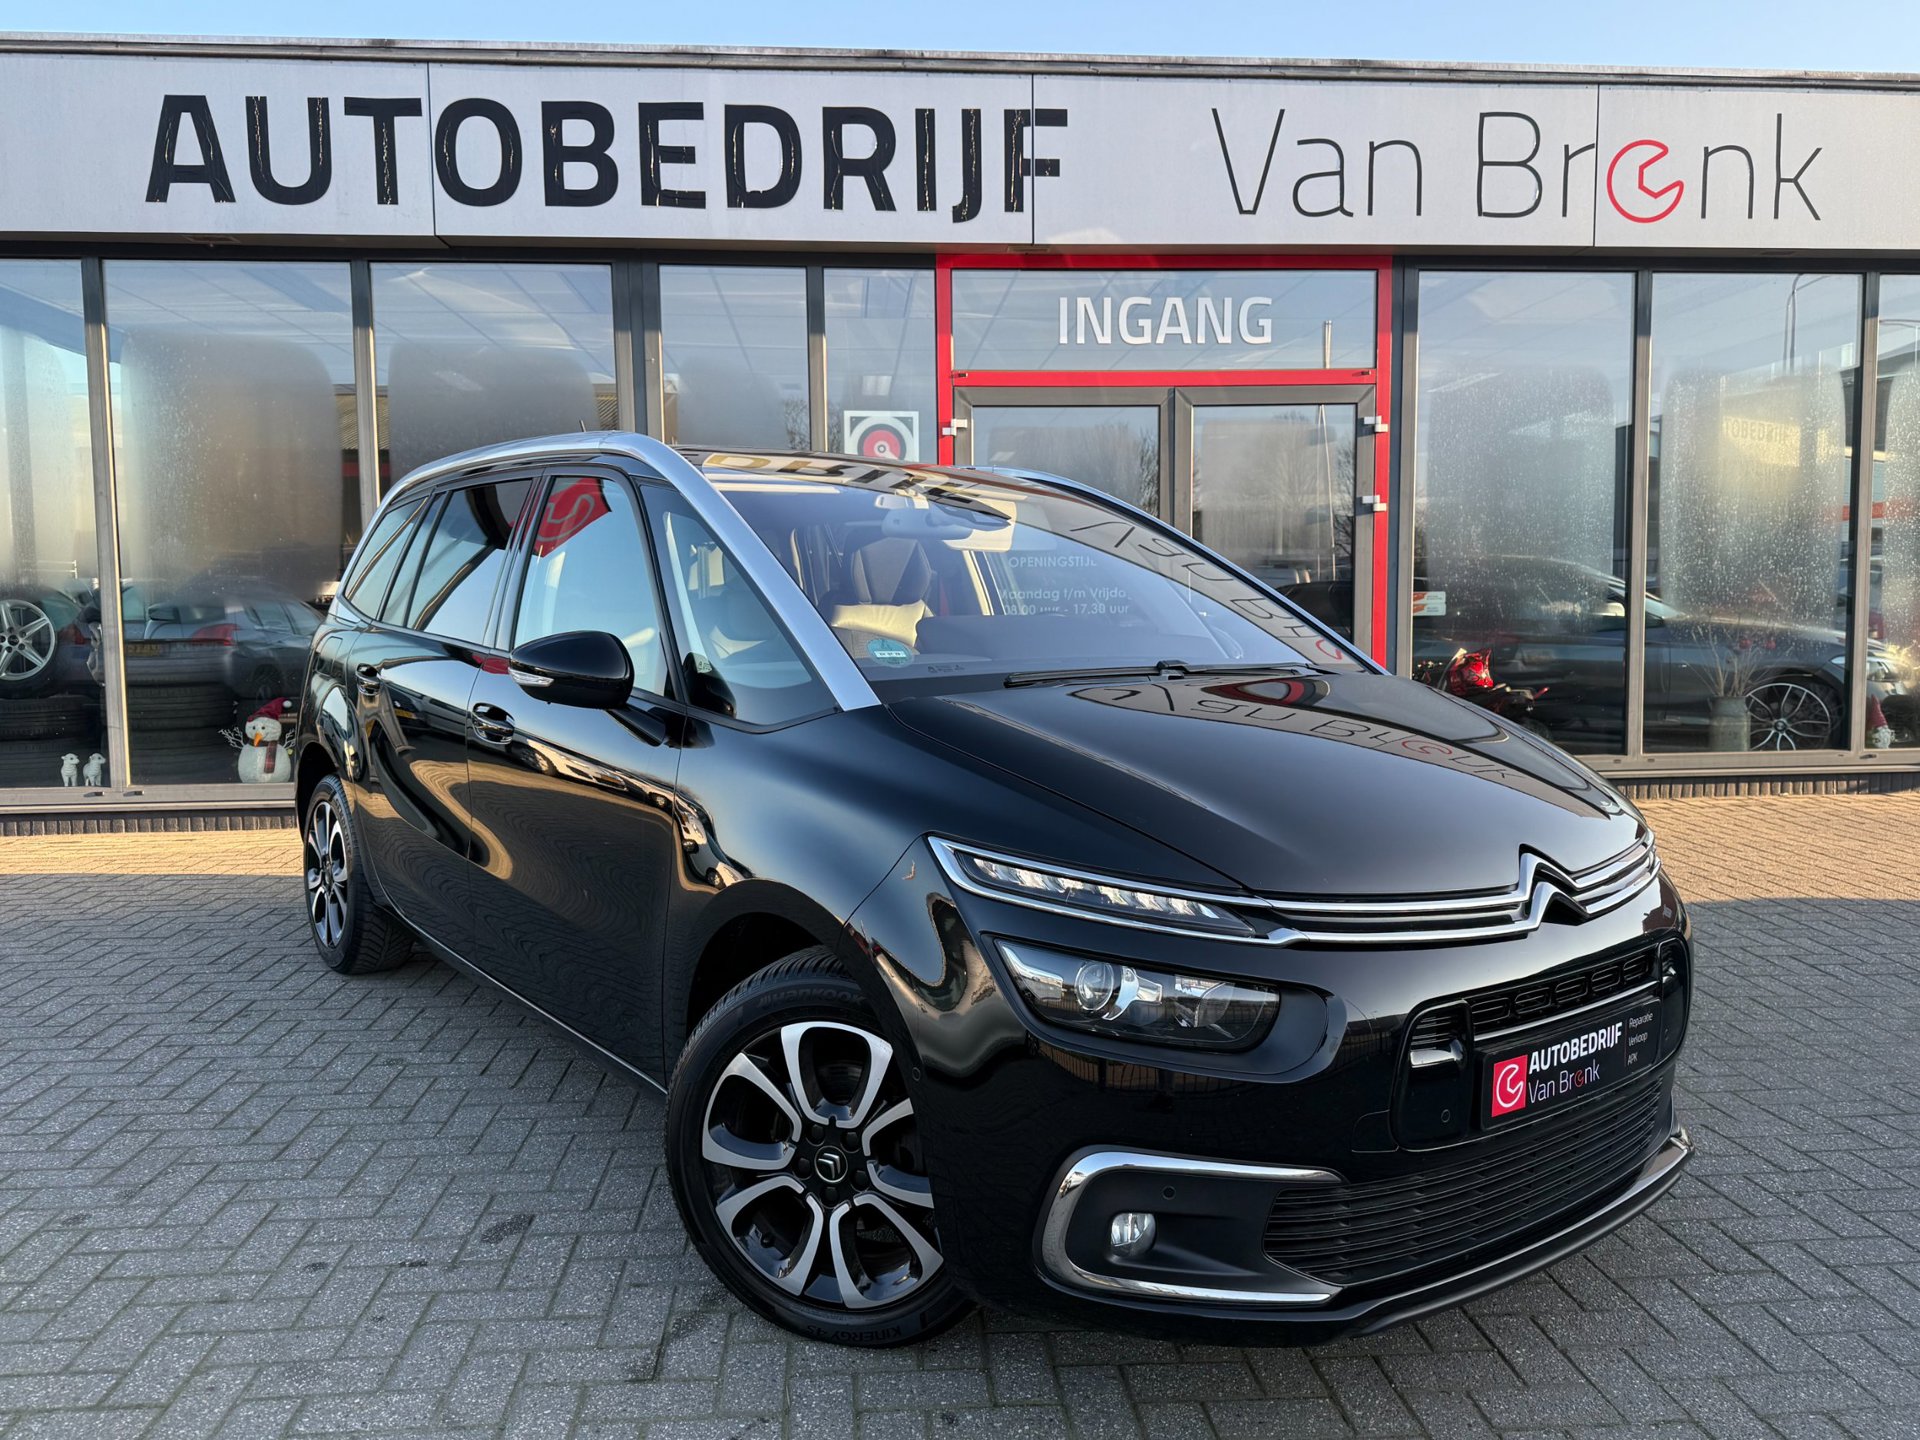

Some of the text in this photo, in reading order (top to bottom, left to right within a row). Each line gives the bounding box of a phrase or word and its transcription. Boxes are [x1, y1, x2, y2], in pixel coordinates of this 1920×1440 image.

[145, 95, 1068, 223] AUTOBEDRIJF
[1211, 108, 1423, 218] Van
[1059, 296, 1273, 345] INGANG
[1063, 588, 1086, 601] t/m
[1089, 586, 1133, 601] Vrijda
[1109, 604, 1129, 614] uur
[1628, 1012, 1653, 1028] Reparatie
[1628, 1032, 1648, 1047] Verkoop
[1529, 1022, 1623, 1074] AUTOBEDRIJF
[1627, 1052, 1638, 1066] APK
[1528, 1079, 1556, 1104] Van
